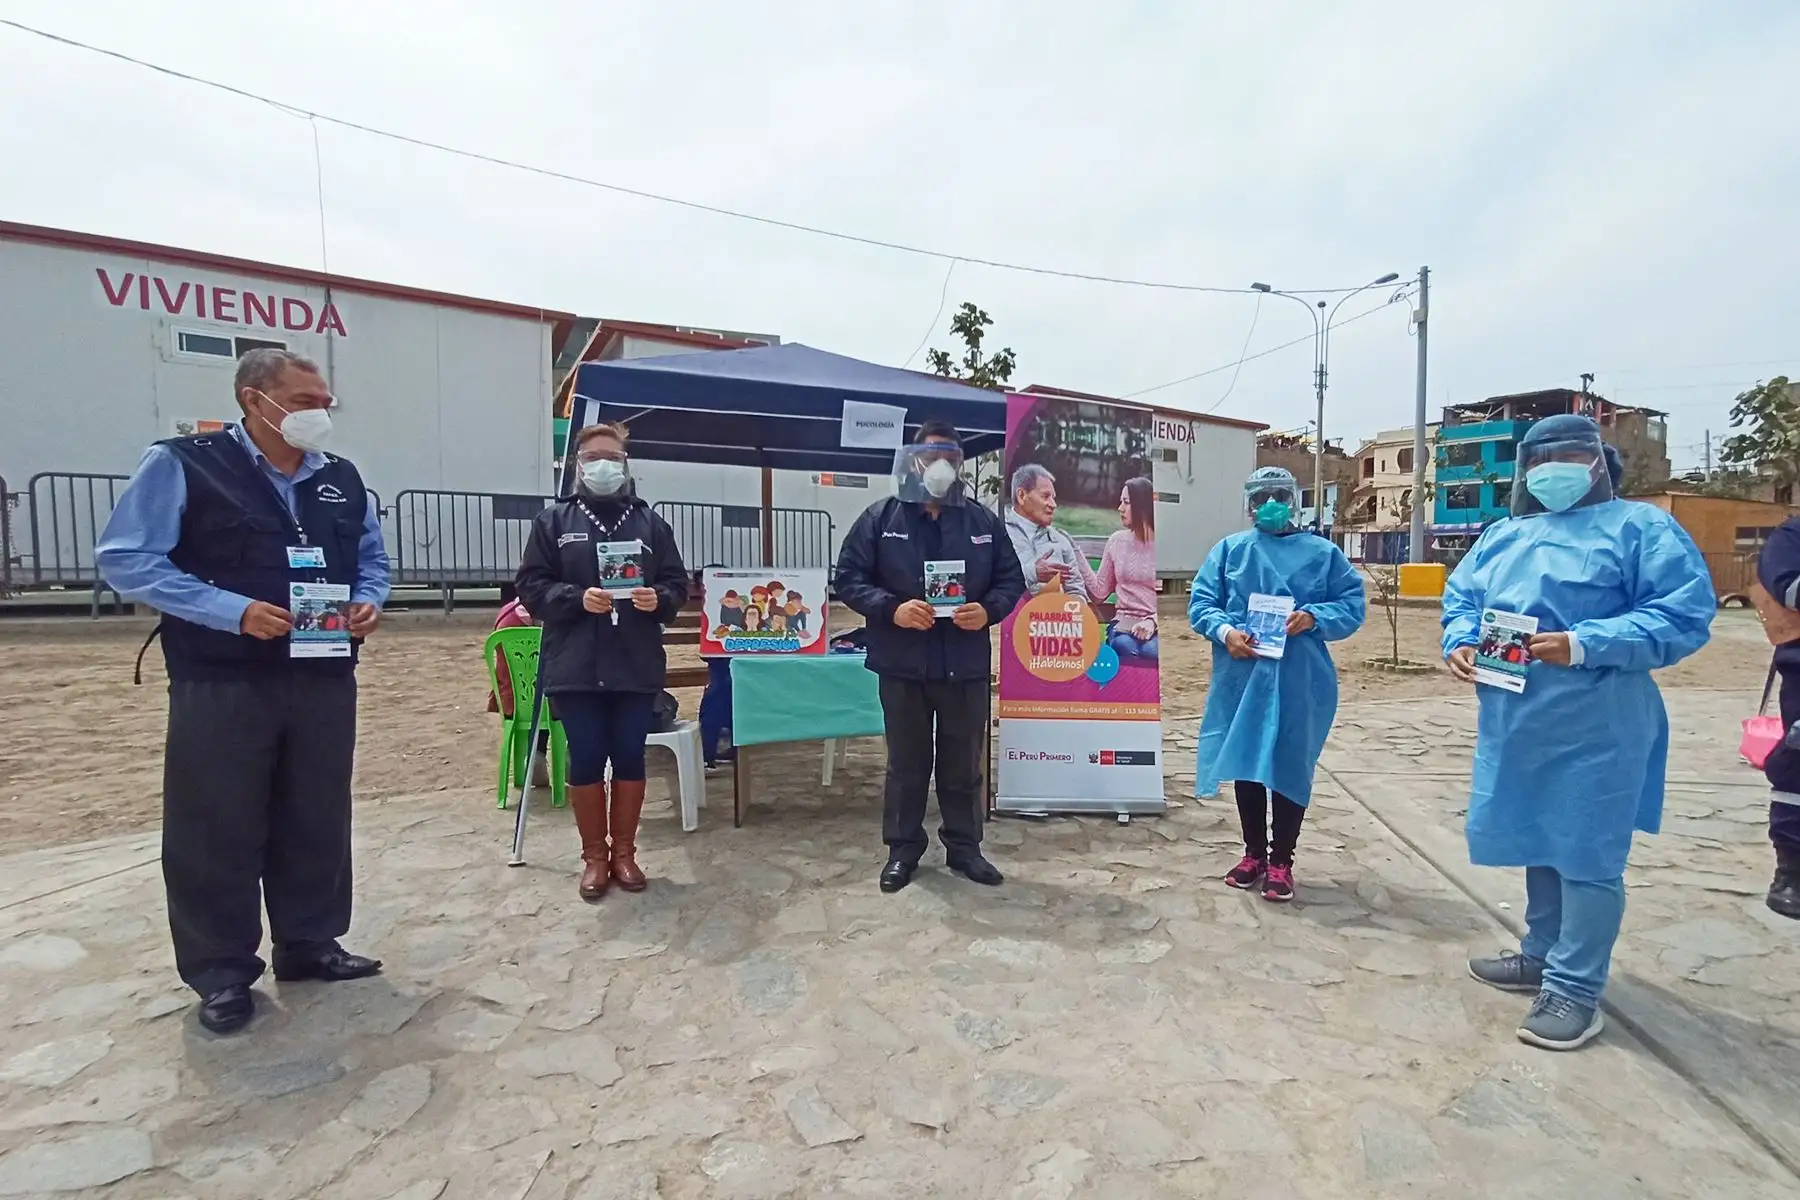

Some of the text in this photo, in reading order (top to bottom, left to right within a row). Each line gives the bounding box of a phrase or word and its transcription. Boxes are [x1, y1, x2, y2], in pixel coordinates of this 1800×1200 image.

[96, 268, 347, 337] VIVIENDA
[1154, 420, 1196, 444] IENDA
[1029, 612, 1072, 621] PALABRAS
[1029, 621, 1083, 637] SALVAN
[1029, 637, 1083, 656] VIDAS
